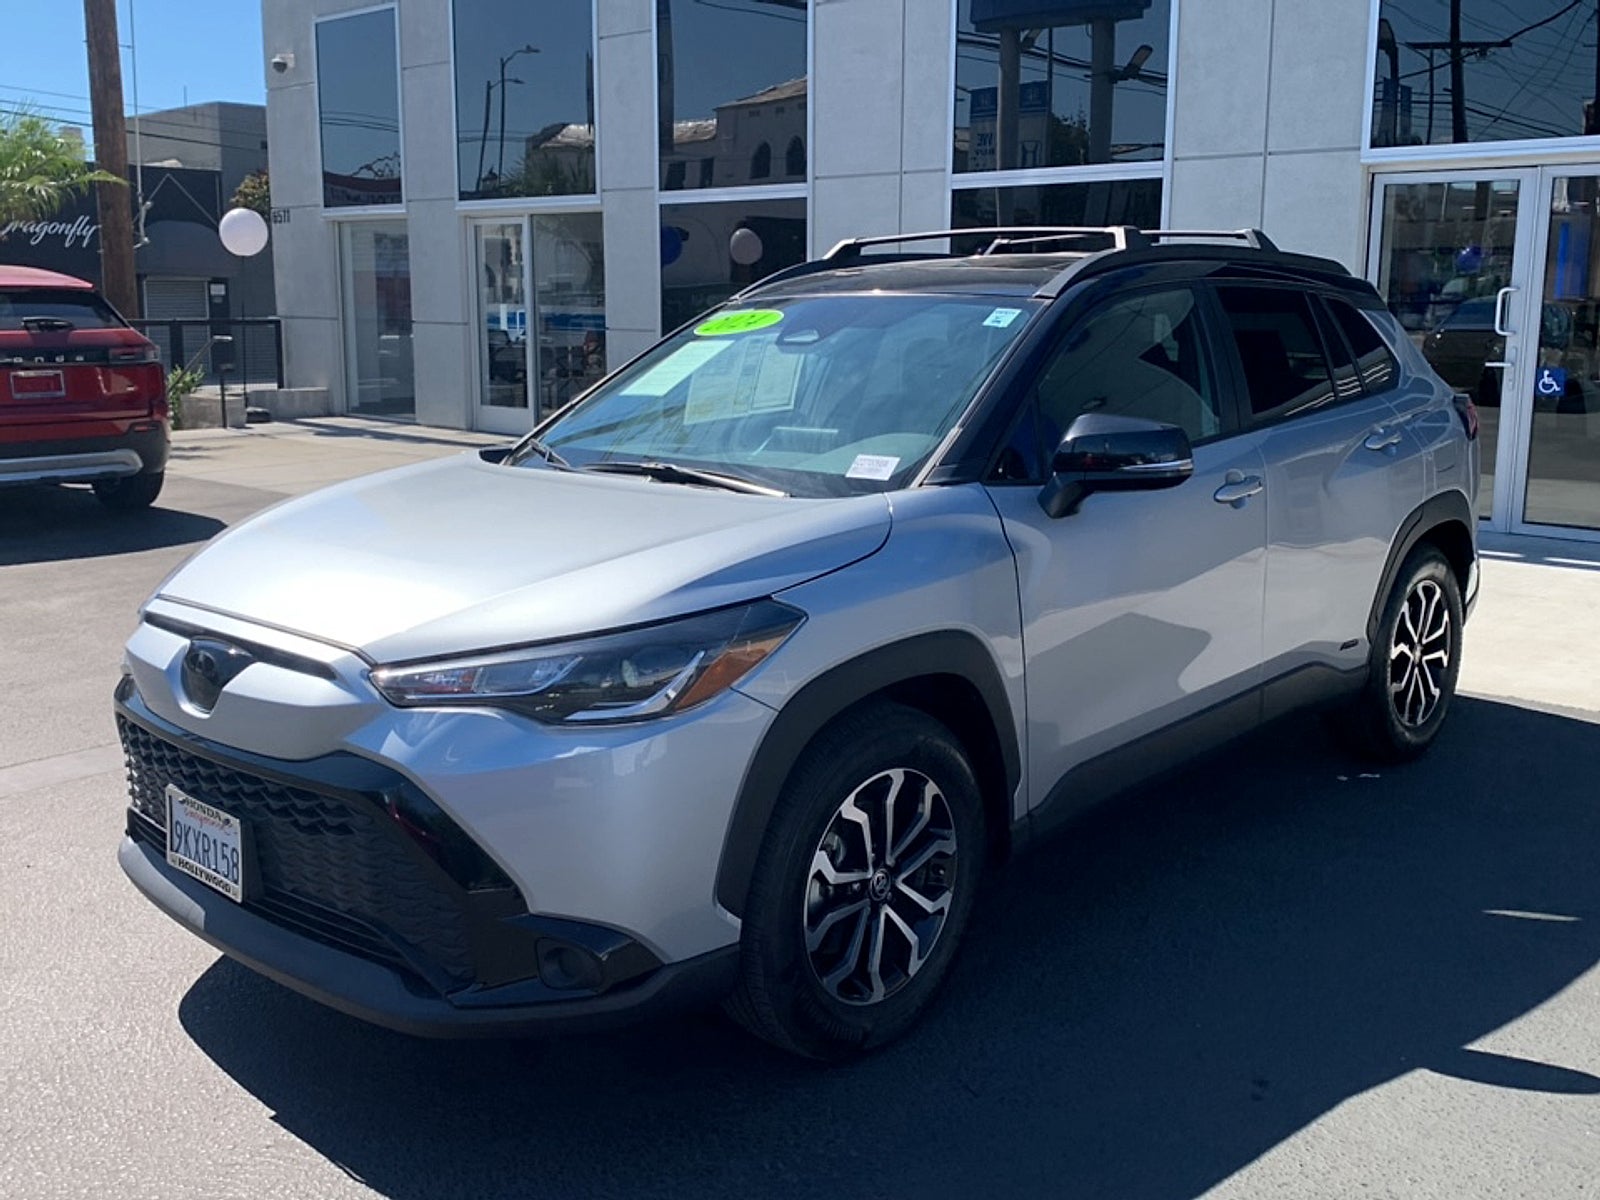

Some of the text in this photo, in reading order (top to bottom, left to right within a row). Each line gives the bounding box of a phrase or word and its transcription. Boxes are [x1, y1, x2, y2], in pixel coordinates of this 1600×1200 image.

[0, 215, 101, 248] ragonfly
[174, 820, 240, 885] 9KXR158
[177, 857, 232, 893] HOLLYWOOD
